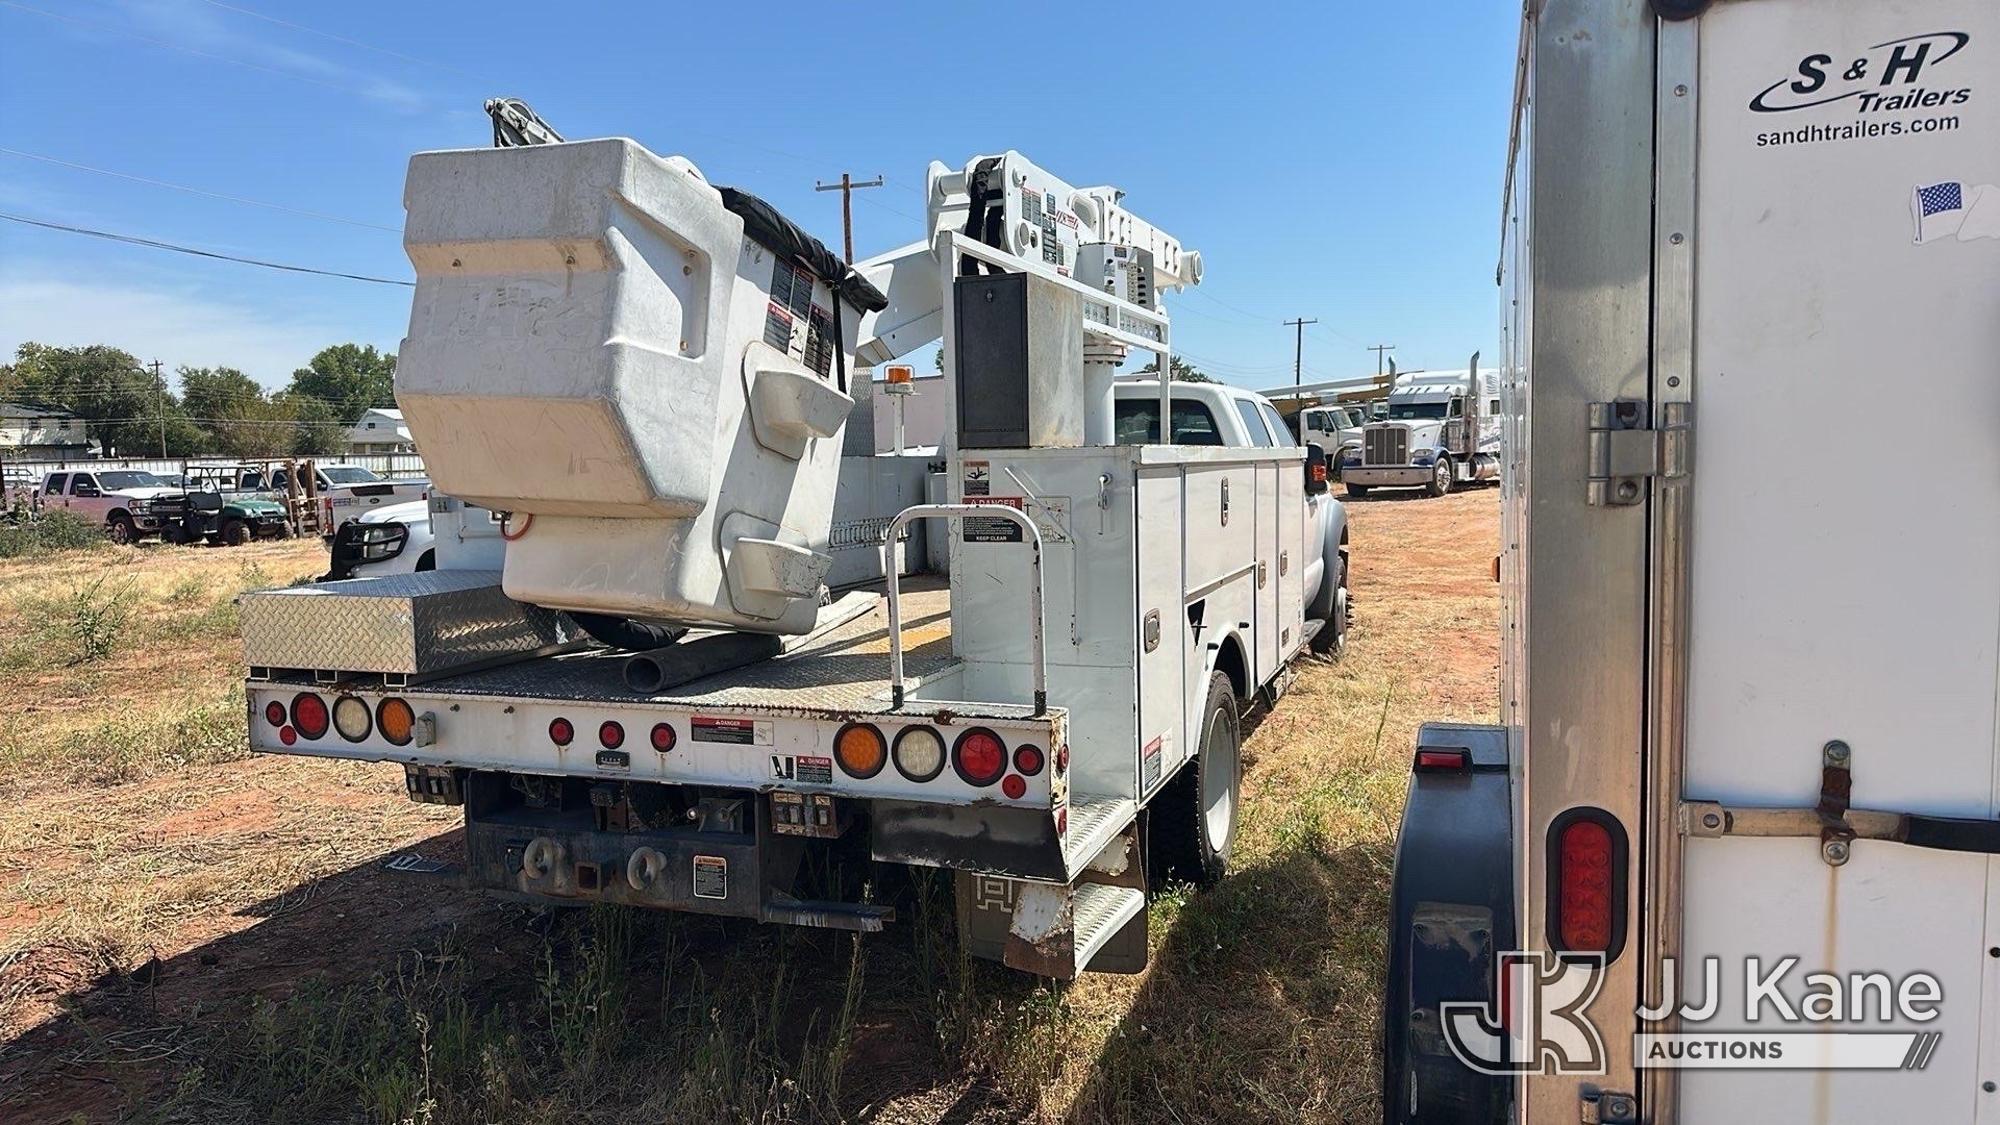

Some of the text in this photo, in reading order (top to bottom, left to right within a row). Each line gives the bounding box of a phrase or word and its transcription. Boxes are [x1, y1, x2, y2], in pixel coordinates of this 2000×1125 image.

[1791, 43, 1932, 94] S & H
[1858, 88, 1971, 113] Trailers
[1757, 116, 1960, 147] sandhtrailers.com
